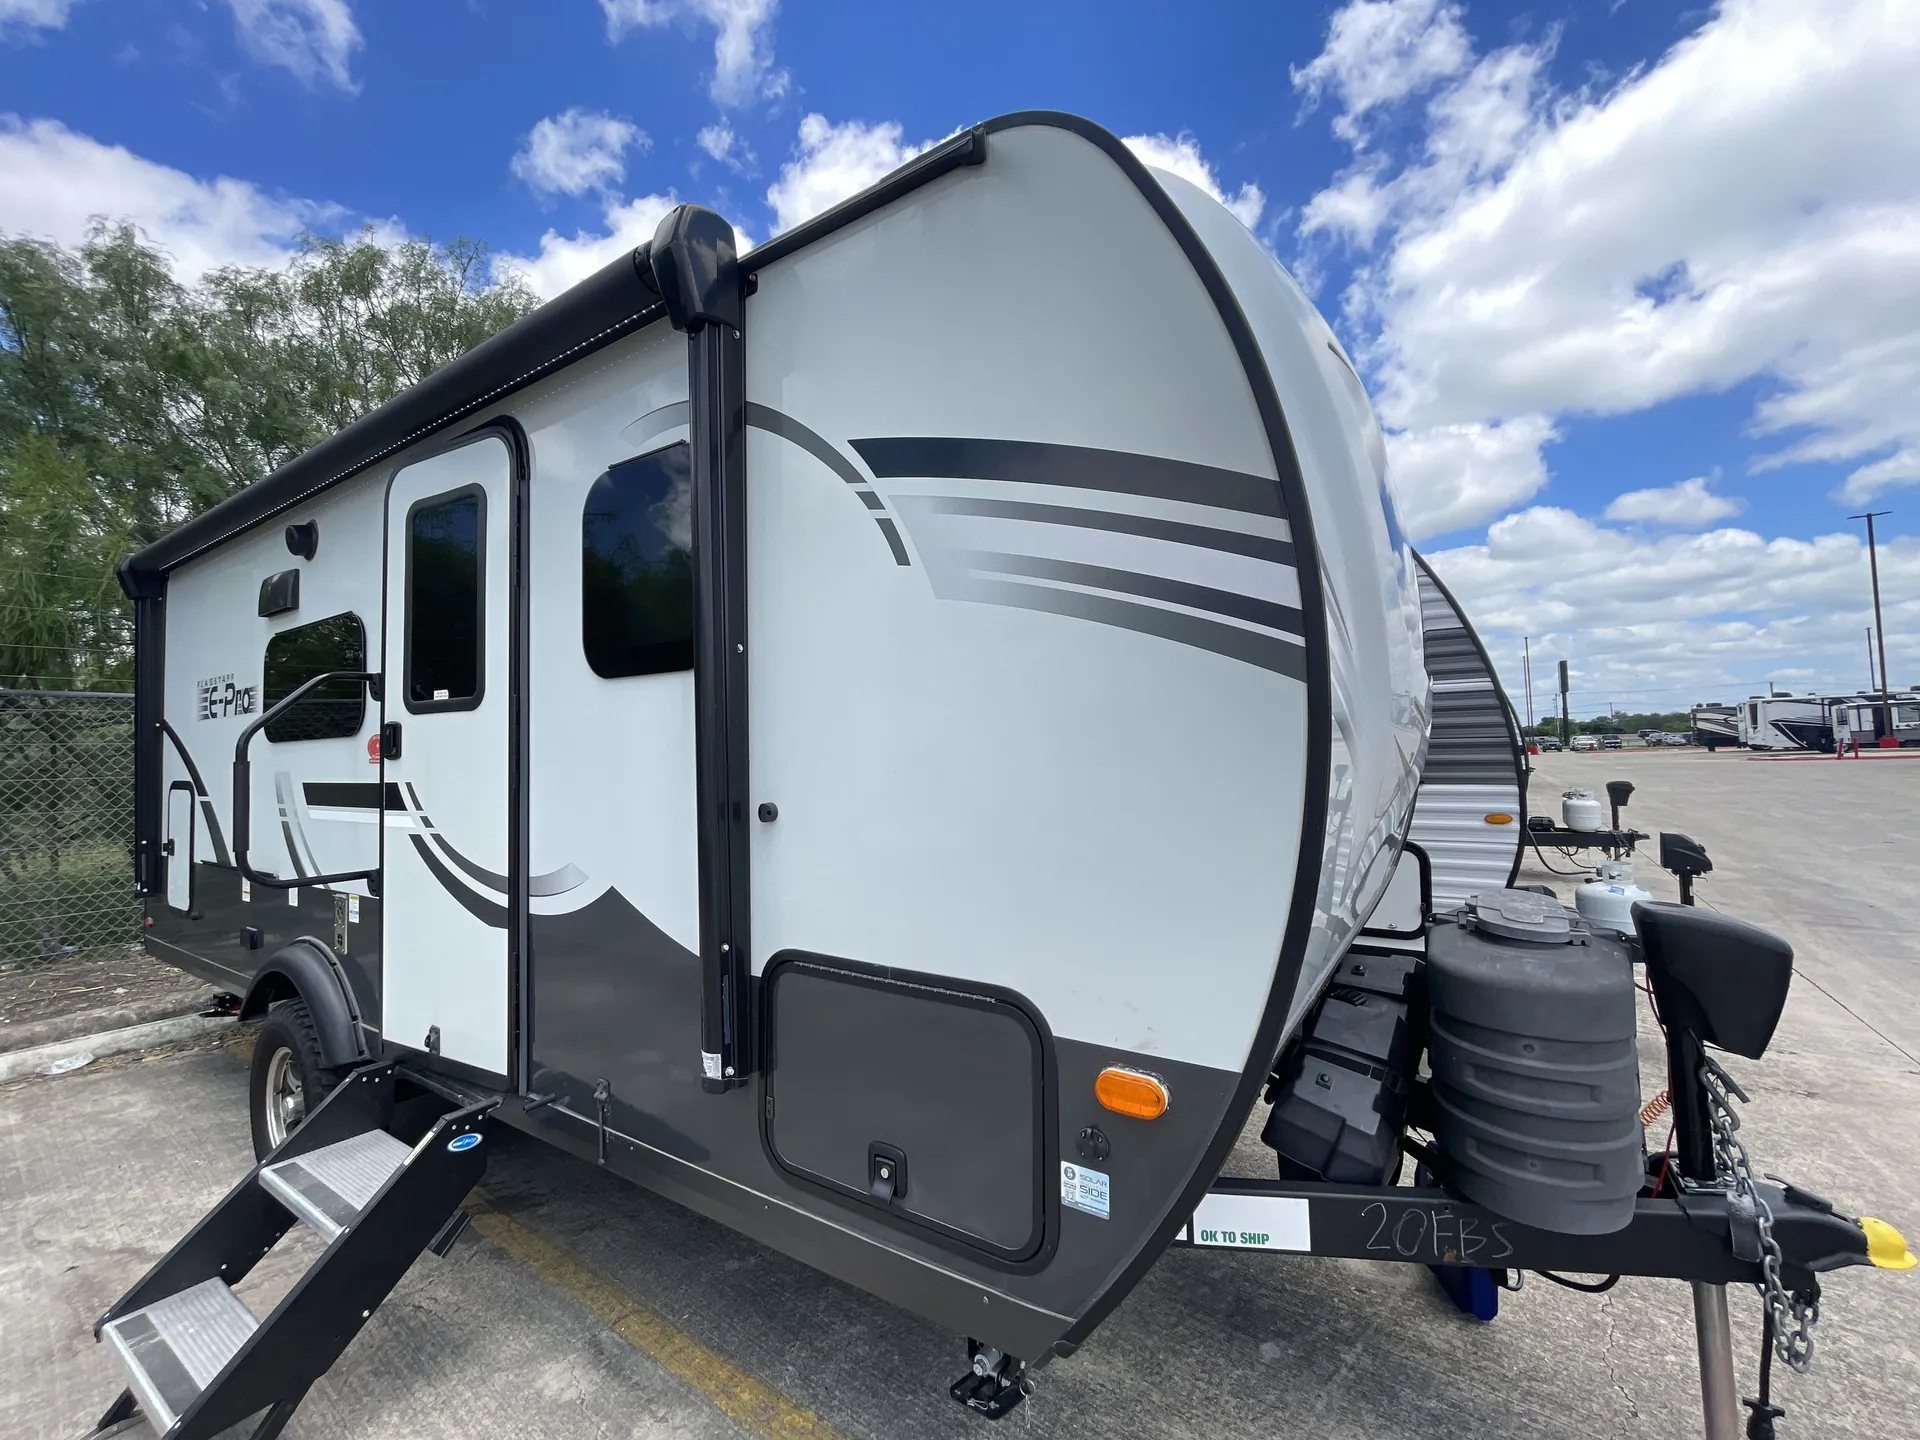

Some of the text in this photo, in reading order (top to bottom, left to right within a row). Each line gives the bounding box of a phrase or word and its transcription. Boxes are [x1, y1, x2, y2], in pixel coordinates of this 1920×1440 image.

[197, 673, 235, 688] FLAGSTAFF
[1079, 1174, 1108, 1188] SOLAR
[1079, 1184, 1108, 1201] SIDE
[1200, 1229, 1270, 1245] OK TO SHIP
